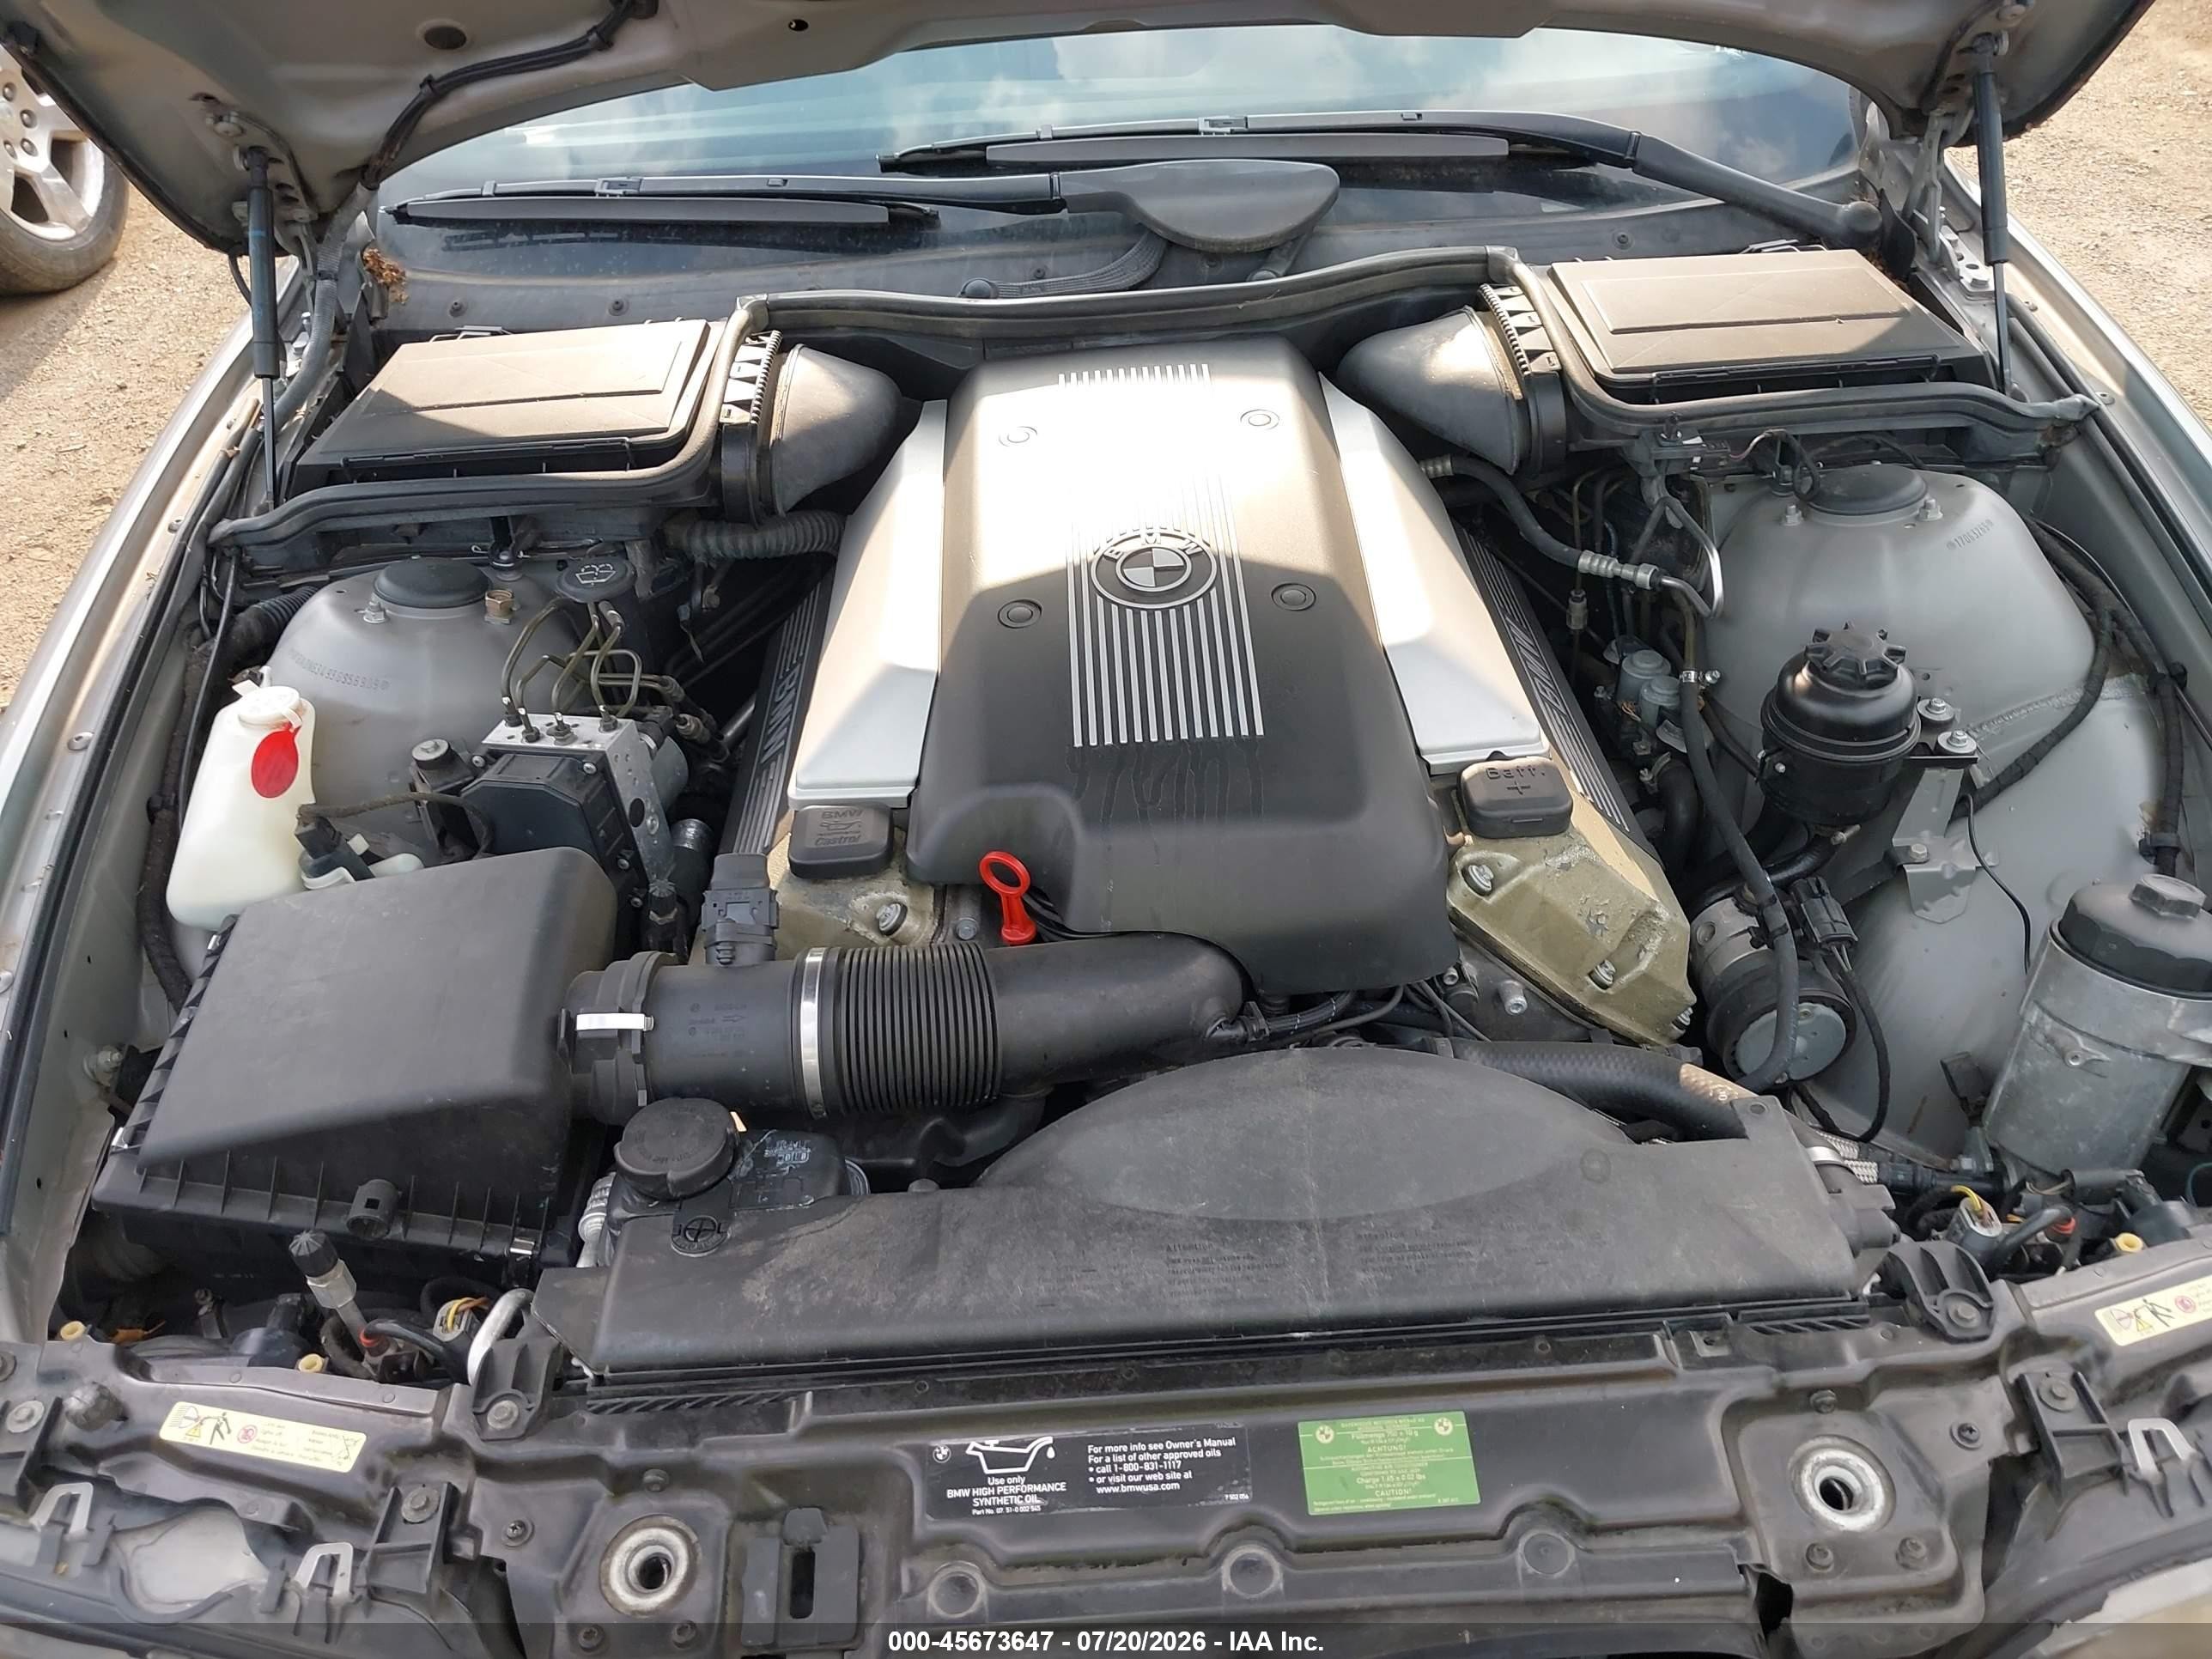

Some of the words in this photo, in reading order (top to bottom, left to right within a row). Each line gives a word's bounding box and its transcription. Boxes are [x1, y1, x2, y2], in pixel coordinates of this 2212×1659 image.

[1103, 532, 1204, 560] BMW
[821, 810, 863, 819] BMW
[815, 835, 861, 846] Castrol
[1087, 1444, 1103, 1454] For
[1130, 1442, 1146, 1451] info
[1165, 1438, 1202, 1450] Owner's
[1203, 1437, 1237, 1447] Manual
[1088, 1455, 1102, 1464] For
[1112, 1453, 1127, 1462] list
[1127, 1453, 1137, 1462] of
[1138, 1451, 1162, 1461] other
[1163, 1449, 1204, 1460] approved
[1205, 1448, 1222, 1457] oils
[1095, 1463, 1112, 1474] call
[1114, 1461, 1182, 1472] 1-800-831-1117
[988, 1477, 1006, 1486] Use
[1006, 1475, 1026, 1486] only
[1096, 1475, 1106, 1484] or
[1107, 1473, 1127, 1484] visit
[1127, 1474, 1143, 1482] our
[1145, 1471, 1164, 1481] web
[1165, 1470, 1182, 1480] site
[1183, 1469, 1194, 1480] at
[946, 1489, 971, 1498] BMW
[972, 1487, 995, 1497] HIGH
[996, 1481, 1067, 1495] PERFORMANCE
[1096, 1481, 1181, 1494] www.bmwusa.com
[972, 1495, 1024, 1507] SYNTHETIC
[1024, 1494, 1041, 1504] OIL
